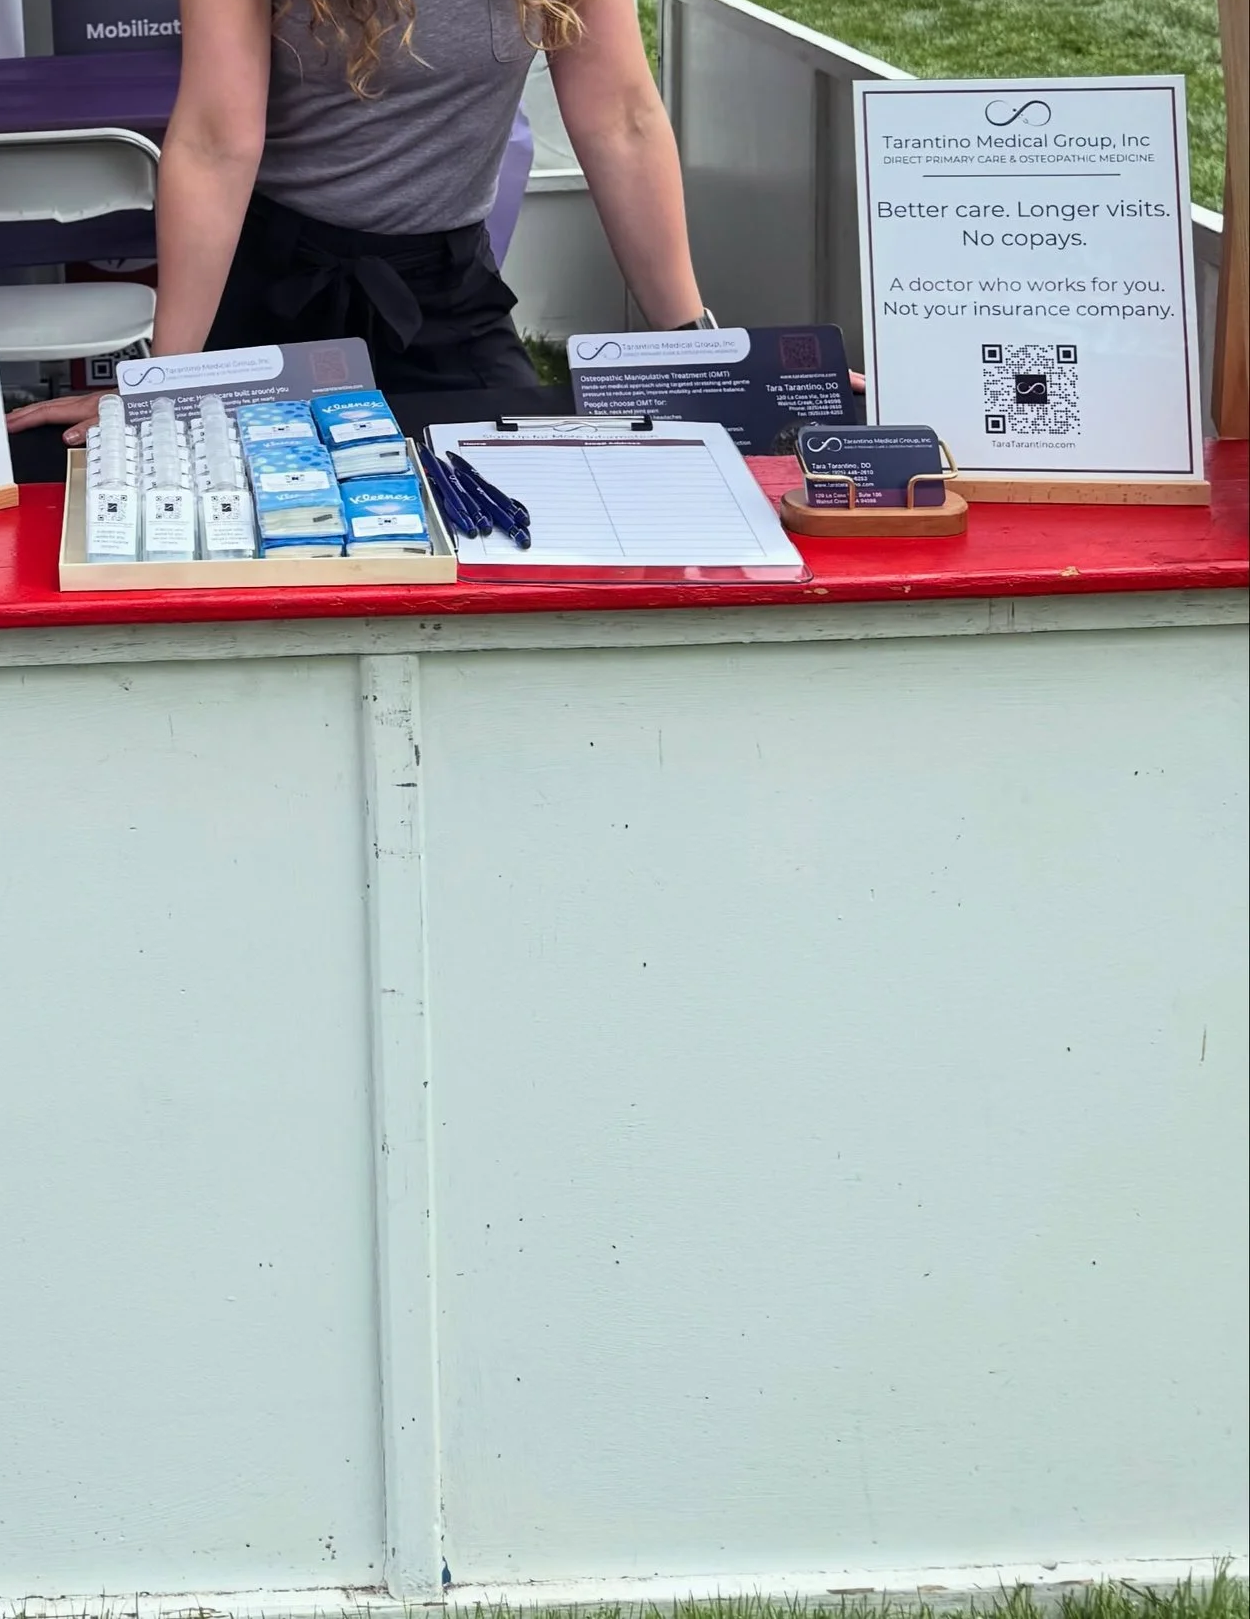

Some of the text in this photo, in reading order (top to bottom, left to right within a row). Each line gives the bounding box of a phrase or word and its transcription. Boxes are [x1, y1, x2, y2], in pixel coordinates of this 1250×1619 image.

[86, 19, 182, 39] Mobilizat
[882, 133, 1150, 151] Tarantino Medical Group, Inc
[883, 153, 1155, 165] DIRECT PRIMARY CARE OSTEOPATHIC MEDICINE
[877, 200, 1171, 221] Better care. Longer visits.
[962, 230, 1087, 250] No copays.
[890, 277, 1165, 296] A doctor who works for you.
[883, 301, 1175, 319] Not your insurance company.
[580, 371, 730, 383] Osteopathic Manipulative Treatment (OMT)
[322, 400, 384, 414] Kleenex
[992, 439, 1076, 449] TaraTarantino.com
[349, 494, 417, 504] Kleenex
